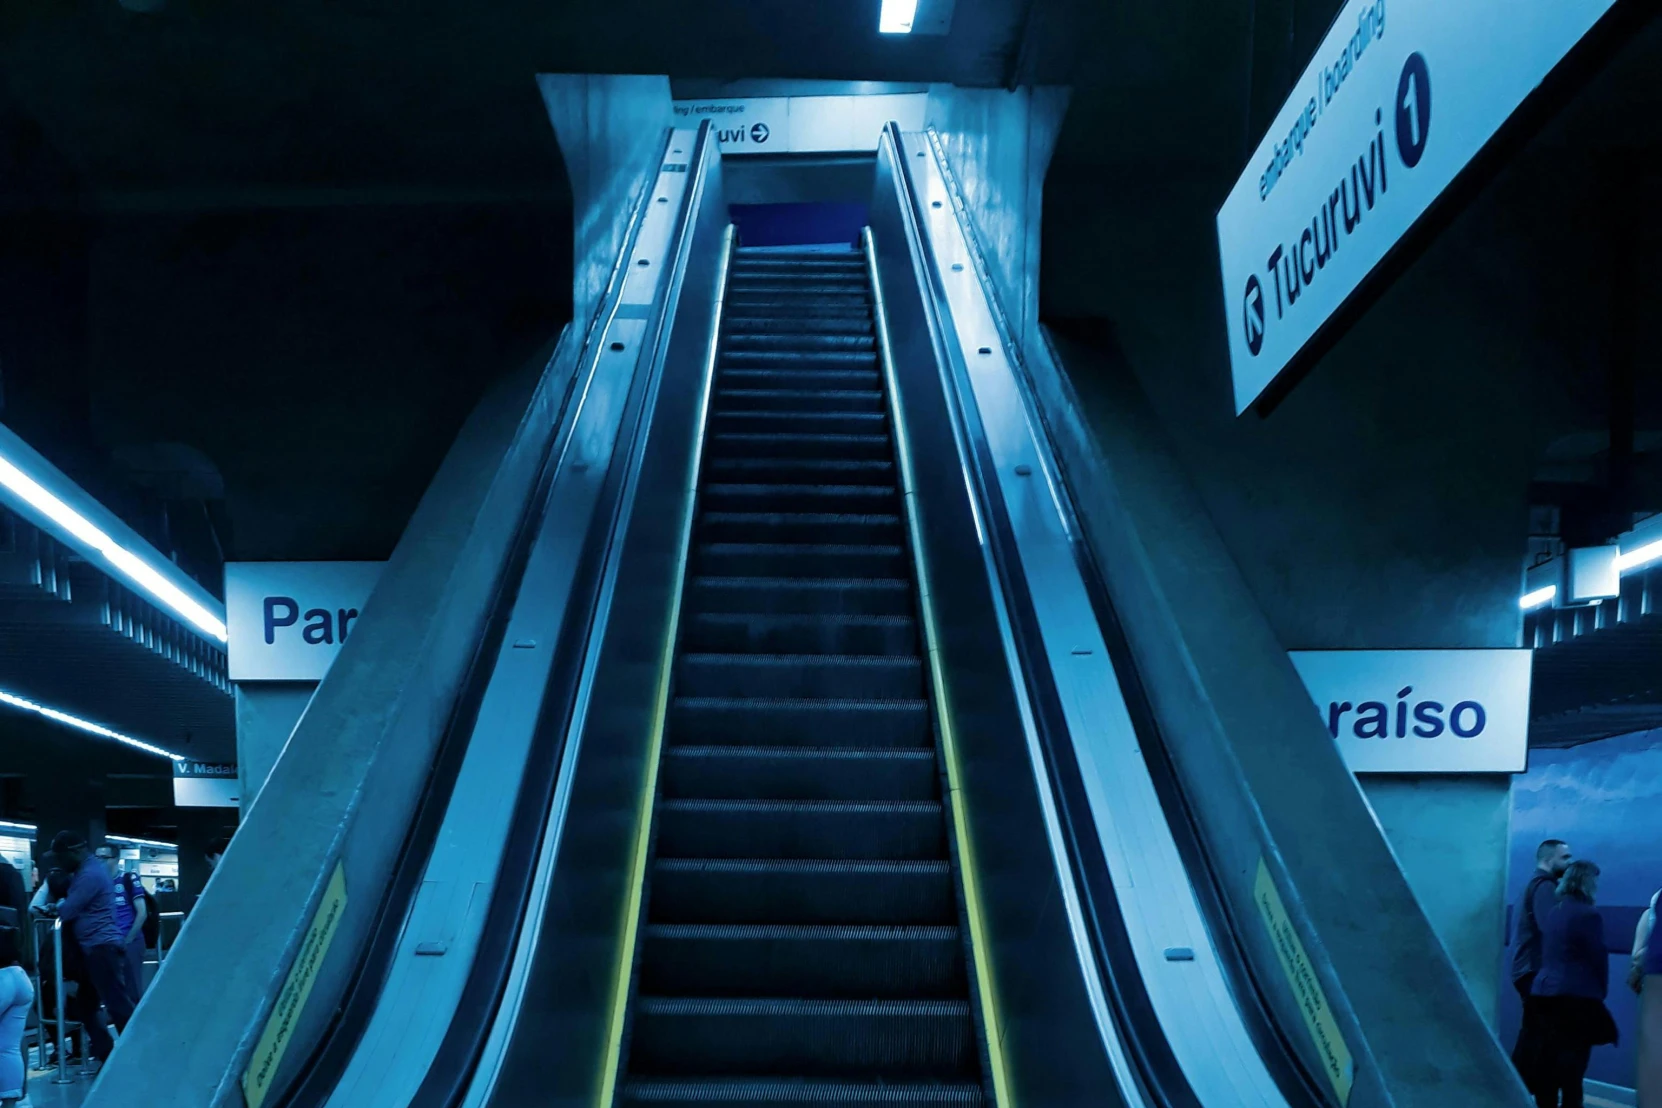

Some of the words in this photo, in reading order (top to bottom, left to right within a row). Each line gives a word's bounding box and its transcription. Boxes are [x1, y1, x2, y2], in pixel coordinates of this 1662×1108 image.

[695, 105, 745, 114] embarque
[1259, 97, 1317, 202] embarque
[1324, 0, 1387, 105] boarding
[1268, 107, 1388, 321] Tucuruvi
[263, 596, 358, 645] Par
[1329, 685, 1486, 739] raíso
[177, 763, 191, 774] V.
